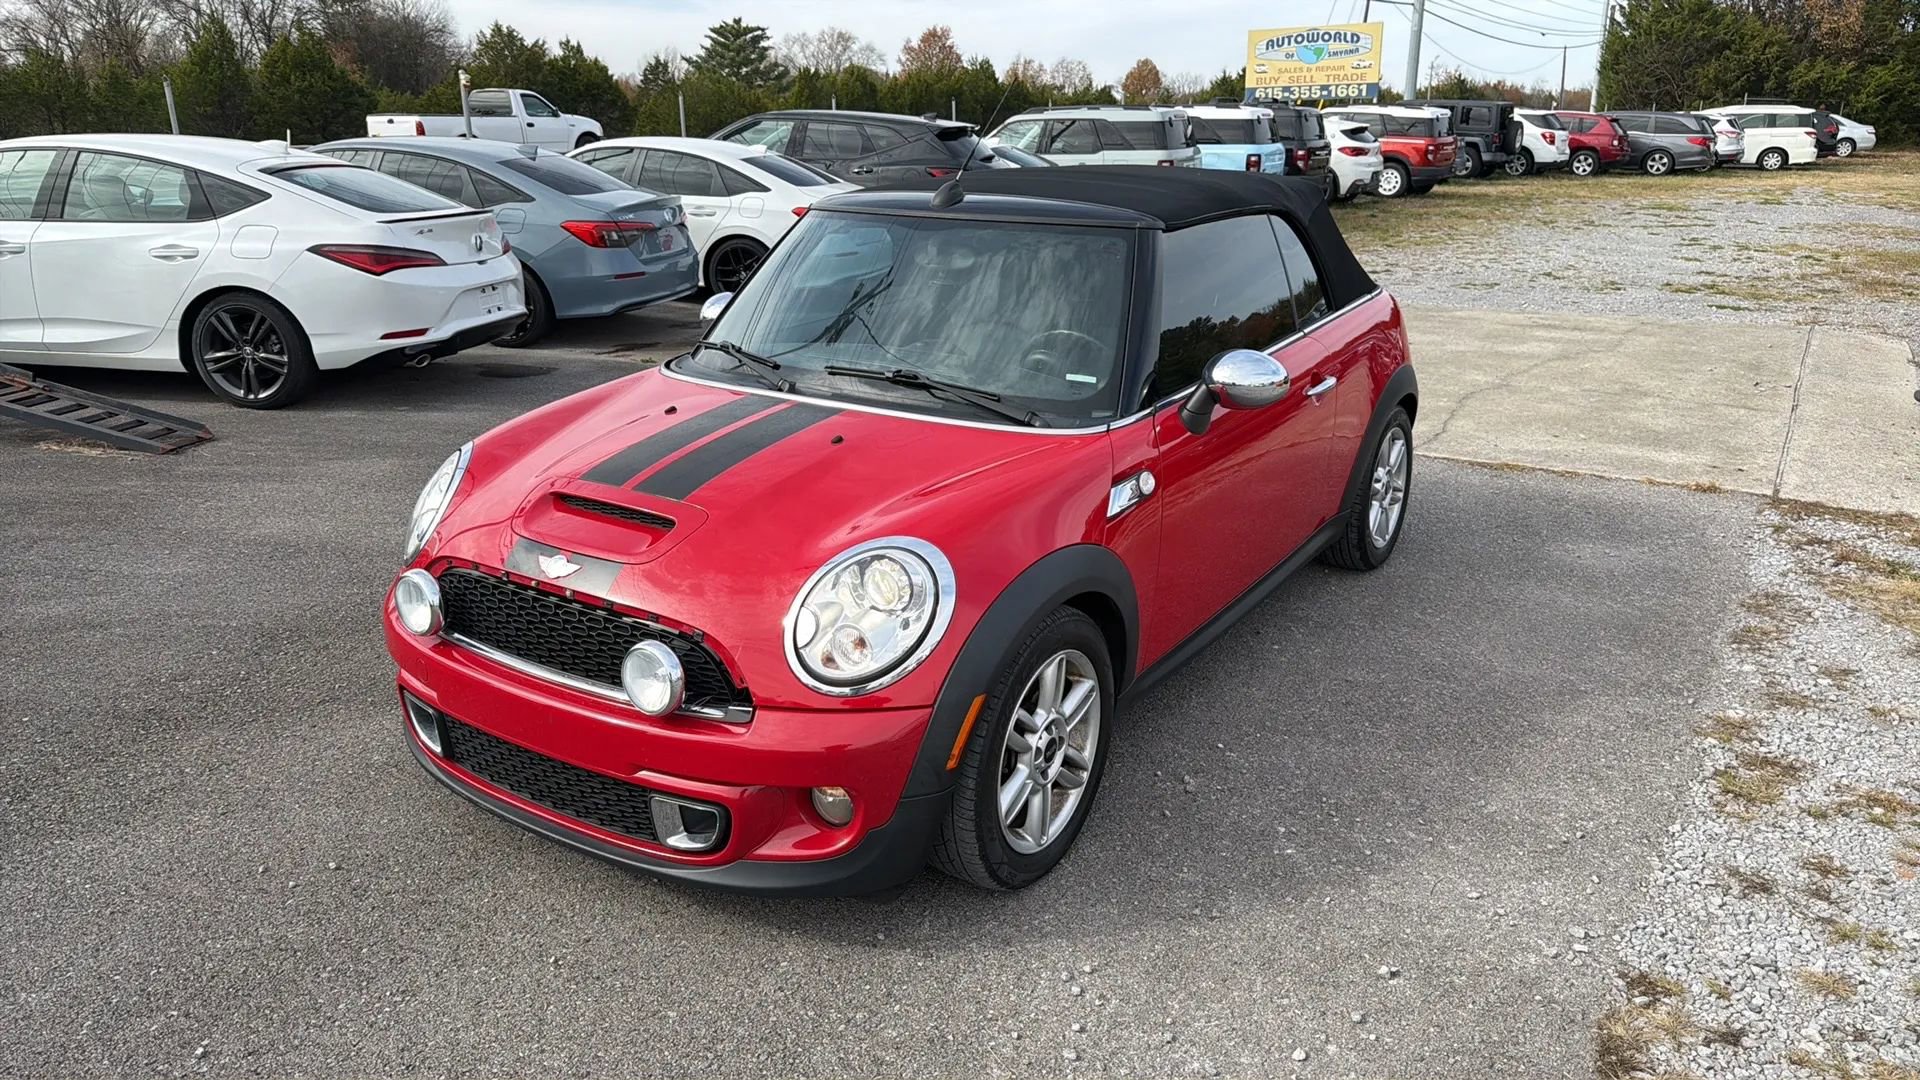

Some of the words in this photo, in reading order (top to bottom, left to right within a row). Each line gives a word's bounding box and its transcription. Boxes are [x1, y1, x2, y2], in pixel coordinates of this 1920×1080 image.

[1265, 31, 1361, 51] AUTOWORLD
[1327, 47, 1360, 57] SMYRNA
[1277, 67, 1304, 75] SALES
[1256, 76, 1280, 85] BUY
[1287, 75, 1317, 84] SELL
[1325, 73, 1368, 83] TRADE
[1255, 84, 1368, 99] 615-355-1661
